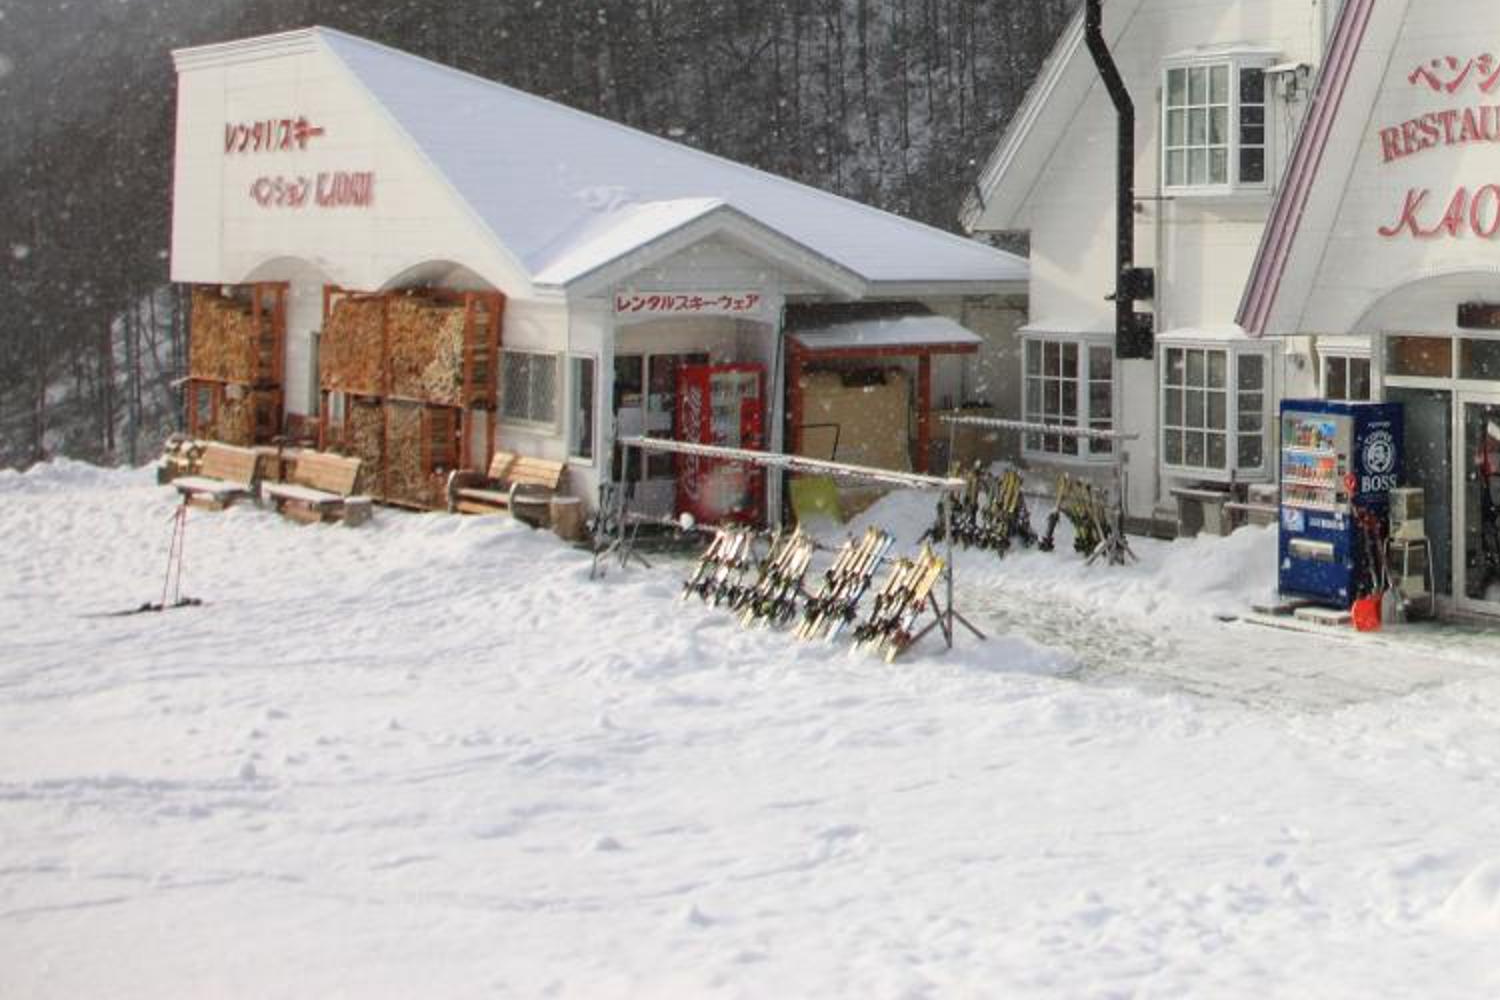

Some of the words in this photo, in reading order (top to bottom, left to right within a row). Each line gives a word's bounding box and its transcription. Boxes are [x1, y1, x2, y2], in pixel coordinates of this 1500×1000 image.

[616, 293, 761, 313] レンタルスキーウェア
[1362, 473, 1398, 493] BOSS
